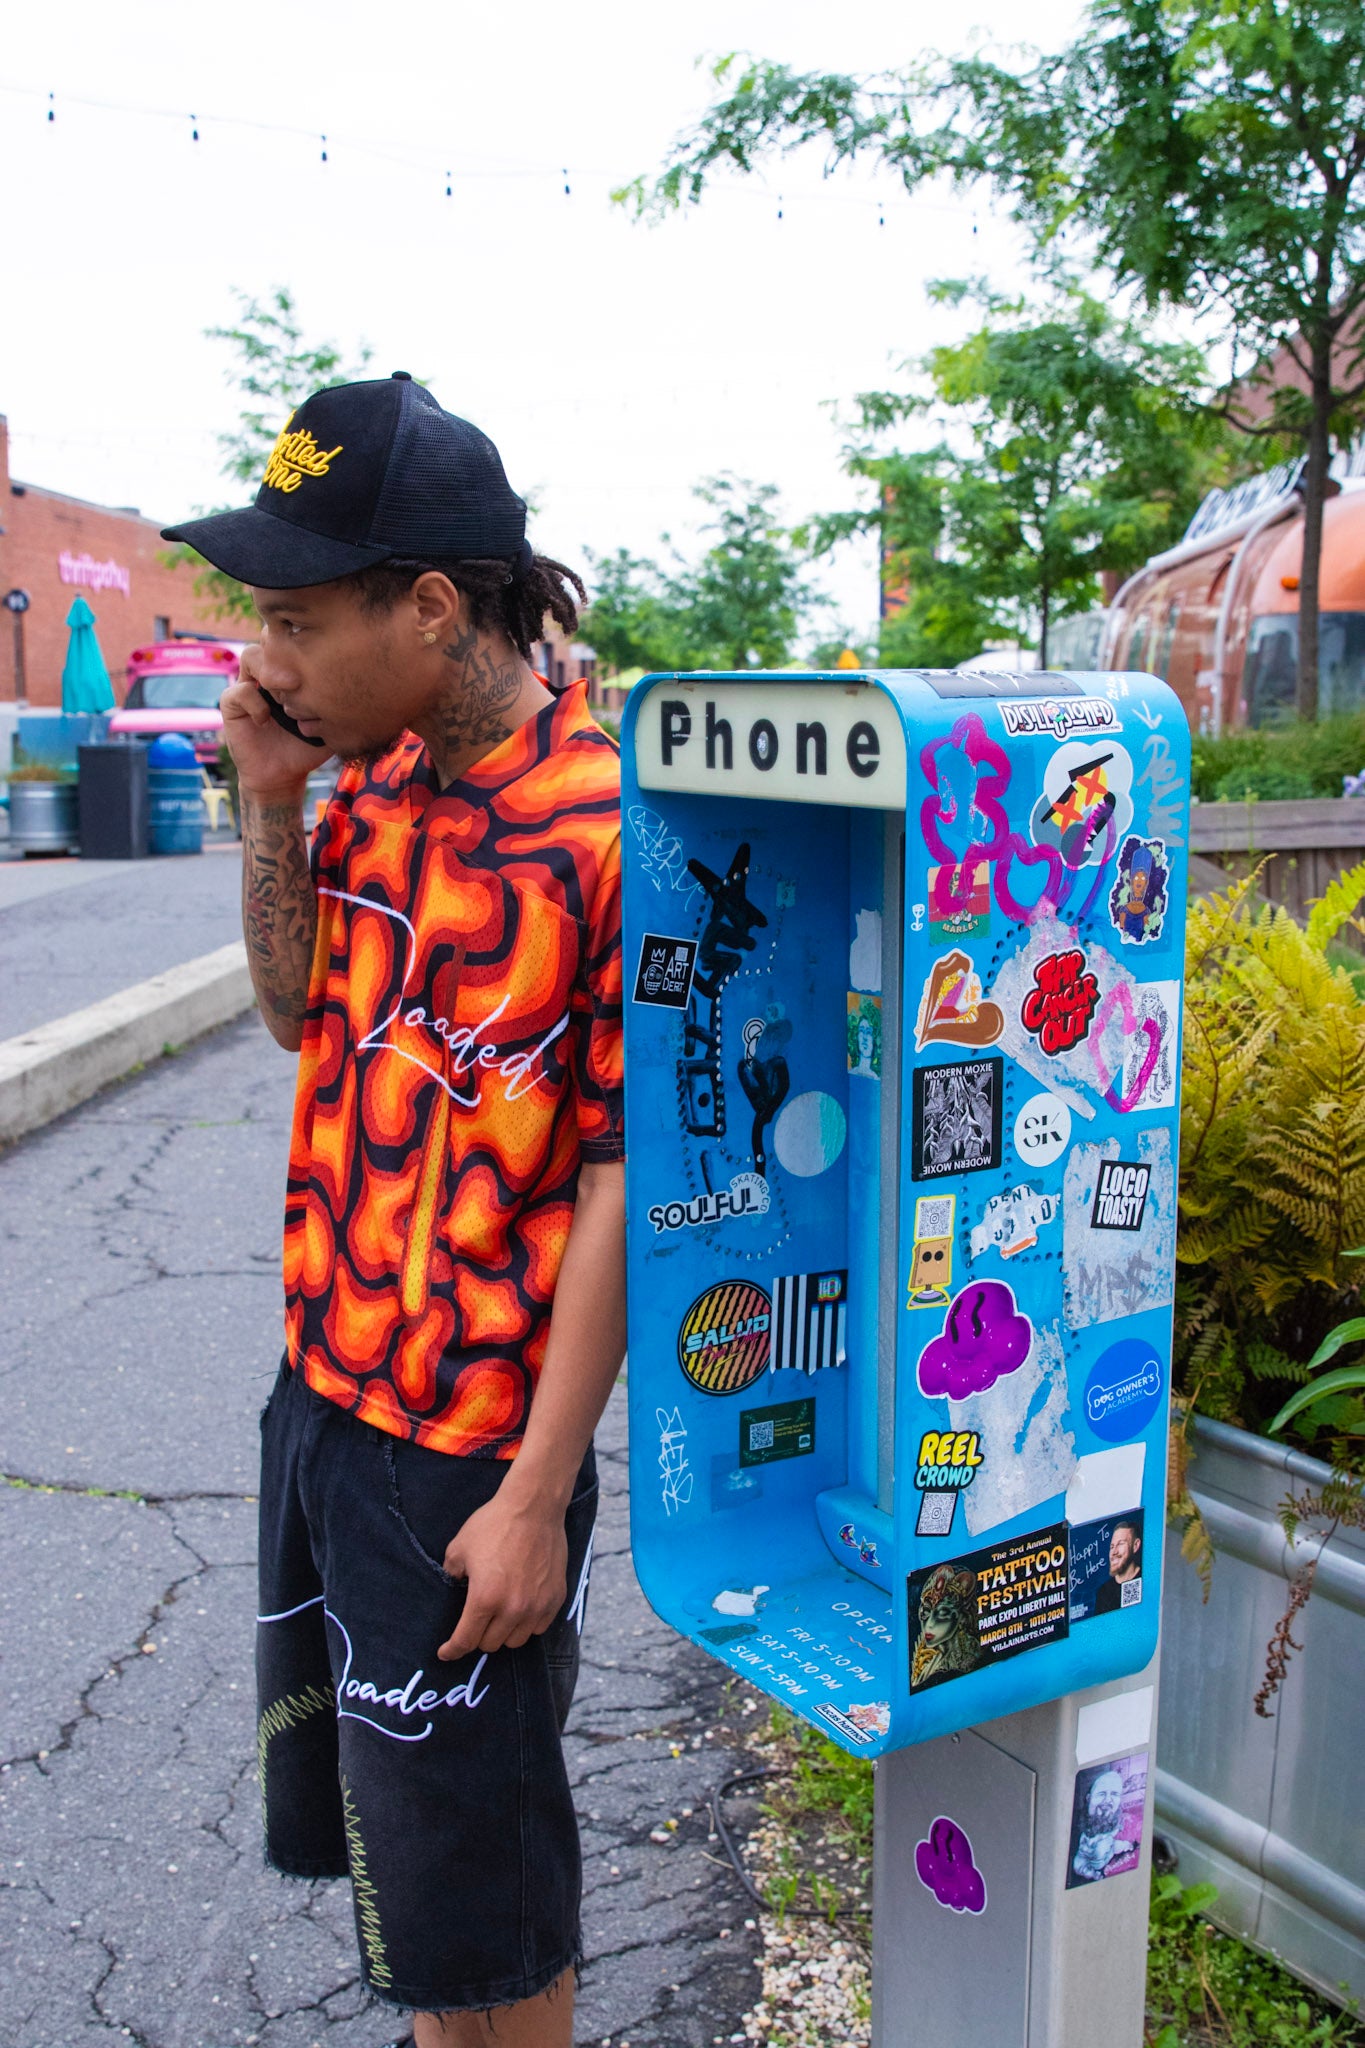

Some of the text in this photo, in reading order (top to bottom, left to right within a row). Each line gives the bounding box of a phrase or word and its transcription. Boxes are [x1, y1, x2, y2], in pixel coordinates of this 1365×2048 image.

[661, 699, 880, 778] Phone
[942, 918, 979, 934] MARLEY
[665, 956, 689, 979] ART
[1036, 951, 1083, 995] TAP
[318, 886, 570, 1107] Loaded
[1024, 974, 1098, 1029] CANCER
[1041, 1003, 1091, 1052] OUT
[924, 1062, 993, 1081] MODERN MOXIE
[731, 1174, 769, 1194] SKATING
[1101, 1165, 1149, 1198] LOCO
[649, 1188, 759, 1232] SOULFUL
[1096, 1194, 1144, 1227] TOASTY
[685, 1313, 770, 1354] SALUD
[1093, 1391, 1115, 1408] DOG
[1115, 1373, 1155, 1398] OWNER'S
[1107, 1388, 1143, 1410] ACADEMY
[919, 1432, 982, 1467] REEL
[916, 1465, 974, 1488] CROWD
[991, 1536, 1052, 1562] The 3rd Annual
[1069, 1523, 1110, 1567] Happy To
[977, 1545, 1066, 1592] TATTOO
[1069, 1557, 1107, 1593] Be Here
[977, 1570, 1066, 1614] FESTIVAL
[978, 1591, 1066, 1630] PARK EXPO LIBERTY HALL
[980, 1629, 1007, 1647] MARCH
[1008, 1622, 1023, 1637] 8TH
[1029, 1614, 1047, 1628] 10TH
[1047, 1607, 1066, 1622] 2024
[992, 1625, 1055, 1653] VILLAINARTS.COM
[323, 1600, 490, 1742] Loaded
[730, 1645, 765, 1666] SUN
[756, 1634, 844, 1691] SAT 5-10 PM
[786, 1627, 876, 1683] FRI 5-10 PM
[819, 1704, 868, 1744] lucas harmon
